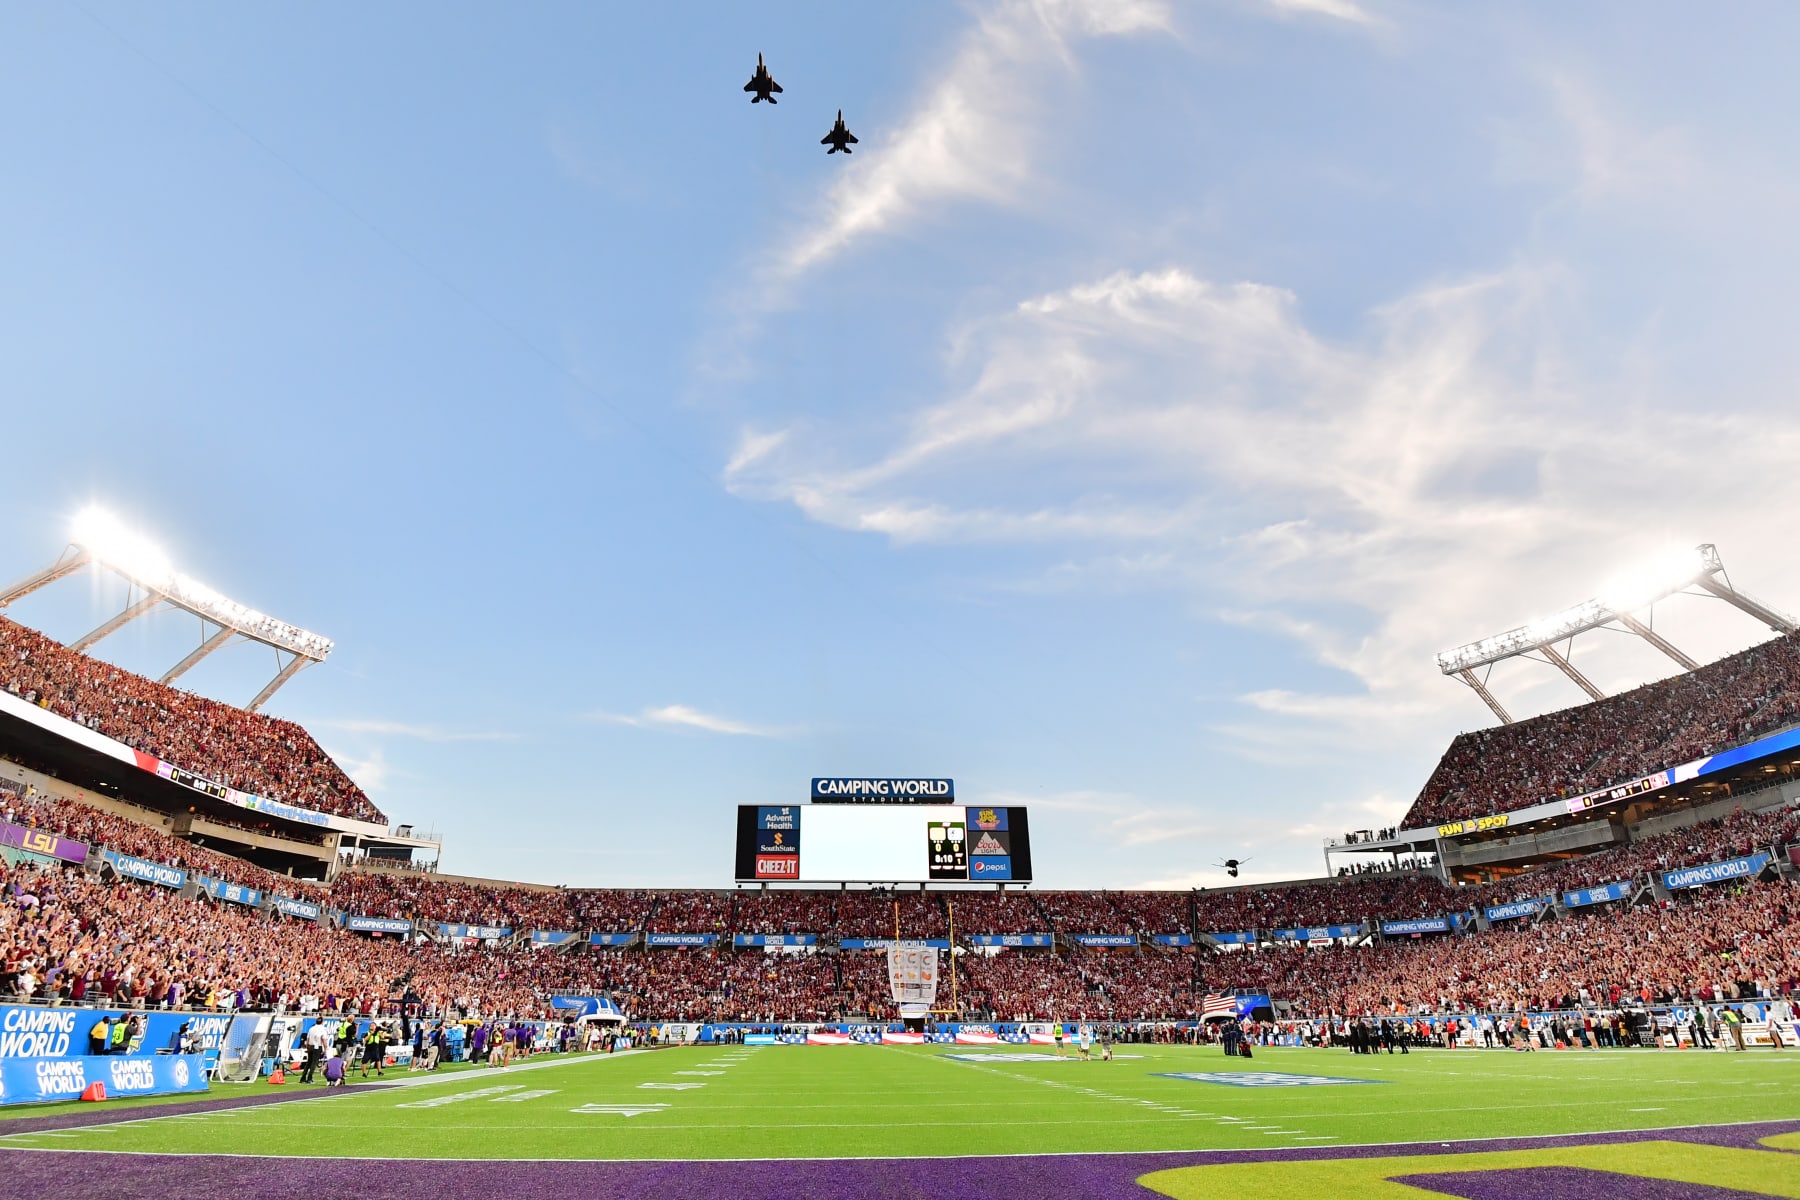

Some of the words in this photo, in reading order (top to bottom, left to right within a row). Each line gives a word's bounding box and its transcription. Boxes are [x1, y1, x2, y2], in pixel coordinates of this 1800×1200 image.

[817, 779, 888, 795] CAMPING
[891, 780, 949, 795] WORLD
[765, 814, 793, 822] Advent
[767, 822, 793, 830] Health
[1438, 823, 1464, 837] FUN
[1478, 815, 1509, 831] SPOT
[22, 830, 59, 854] LSU
[117, 857, 154, 878] CAMPING
[154, 866, 181, 885] WORLD
[1668, 868, 1712, 888] CAMPING
[1712, 861, 1750, 880] WORLD
[299, 903, 318, 917] WORLD
[1488, 905, 1517, 919] CAMPING
[351, 919, 384, 929] CAMPING
[384, 921, 411, 930] WORLD
[1383, 923, 1414, 932] CAMPING
[1416, 921, 1445, 930] WORLD
[4, 1009, 76, 1033] CAMPING
[0, 1032, 70, 1057] WORLD
[36, 1061, 84, 1076] CAMPING
[110, 1060, 153, 1074] CAMPING
[37, 1075, 86, 1095] WORLD
[111, 1072, 154, 1090] WORLD
[96, 1083, 105, 1099] 10
